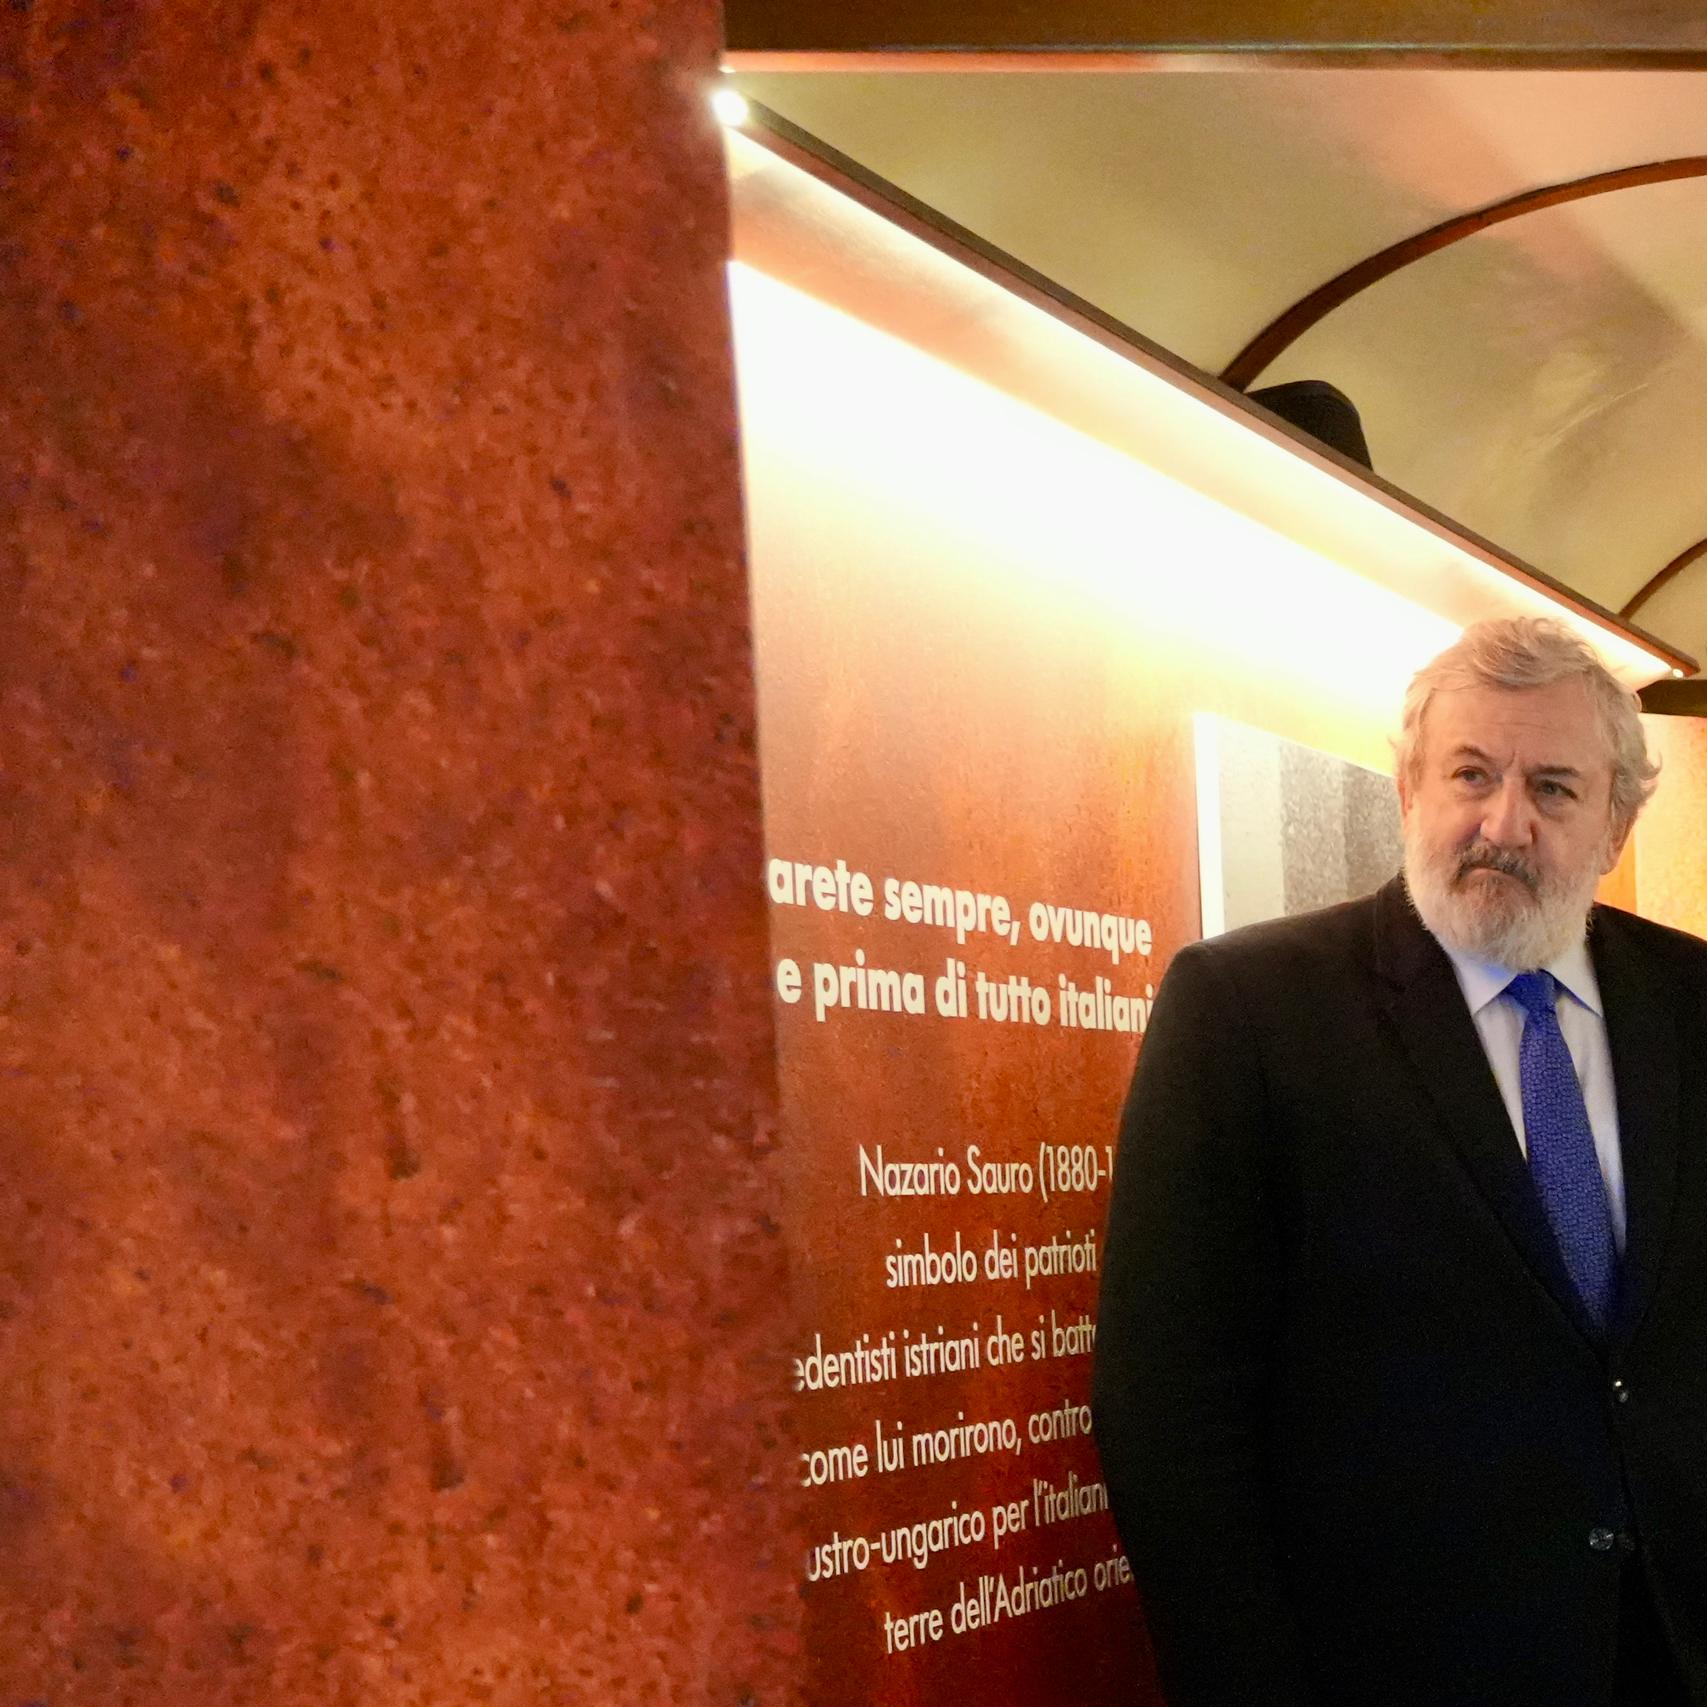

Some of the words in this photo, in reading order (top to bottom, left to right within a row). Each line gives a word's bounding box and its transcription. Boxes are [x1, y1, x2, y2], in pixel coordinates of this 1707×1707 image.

[884, 877, 1021, 945] sempre,
[1029, 901, 1152, 964] ovunque
[813, 949, 925, 1022] prima
[935, 958, 967, 1018] di
[976, 971, 1051, 1025] tutto
[859, 1144, 960, 1197] Nazario
[967, 1144, 1033, 1194] Sauro
[885, 1233, 977, 1288] simbolo
[984, 1230, 1018, 1281] dei
[1025, 1229, 1097, 1289] patrioti
[903, 1322, 980, 1378] istriani
[987, 1315, 1025, 1366] che
[1030, 1315, 1046, 1362] si
[875, 1419, 904, 1473] lui
[912, 1411, 1022, 1467] morirono,
[1028, 1399, 1092, 1444] contro
[992, 1498, 1030, 1550] per
[884, 1609, 943, 1654] terre
[950, 1559, 1088, 1635] dell'Adriatico
[1093, 1544, 1136, 1593] orie
